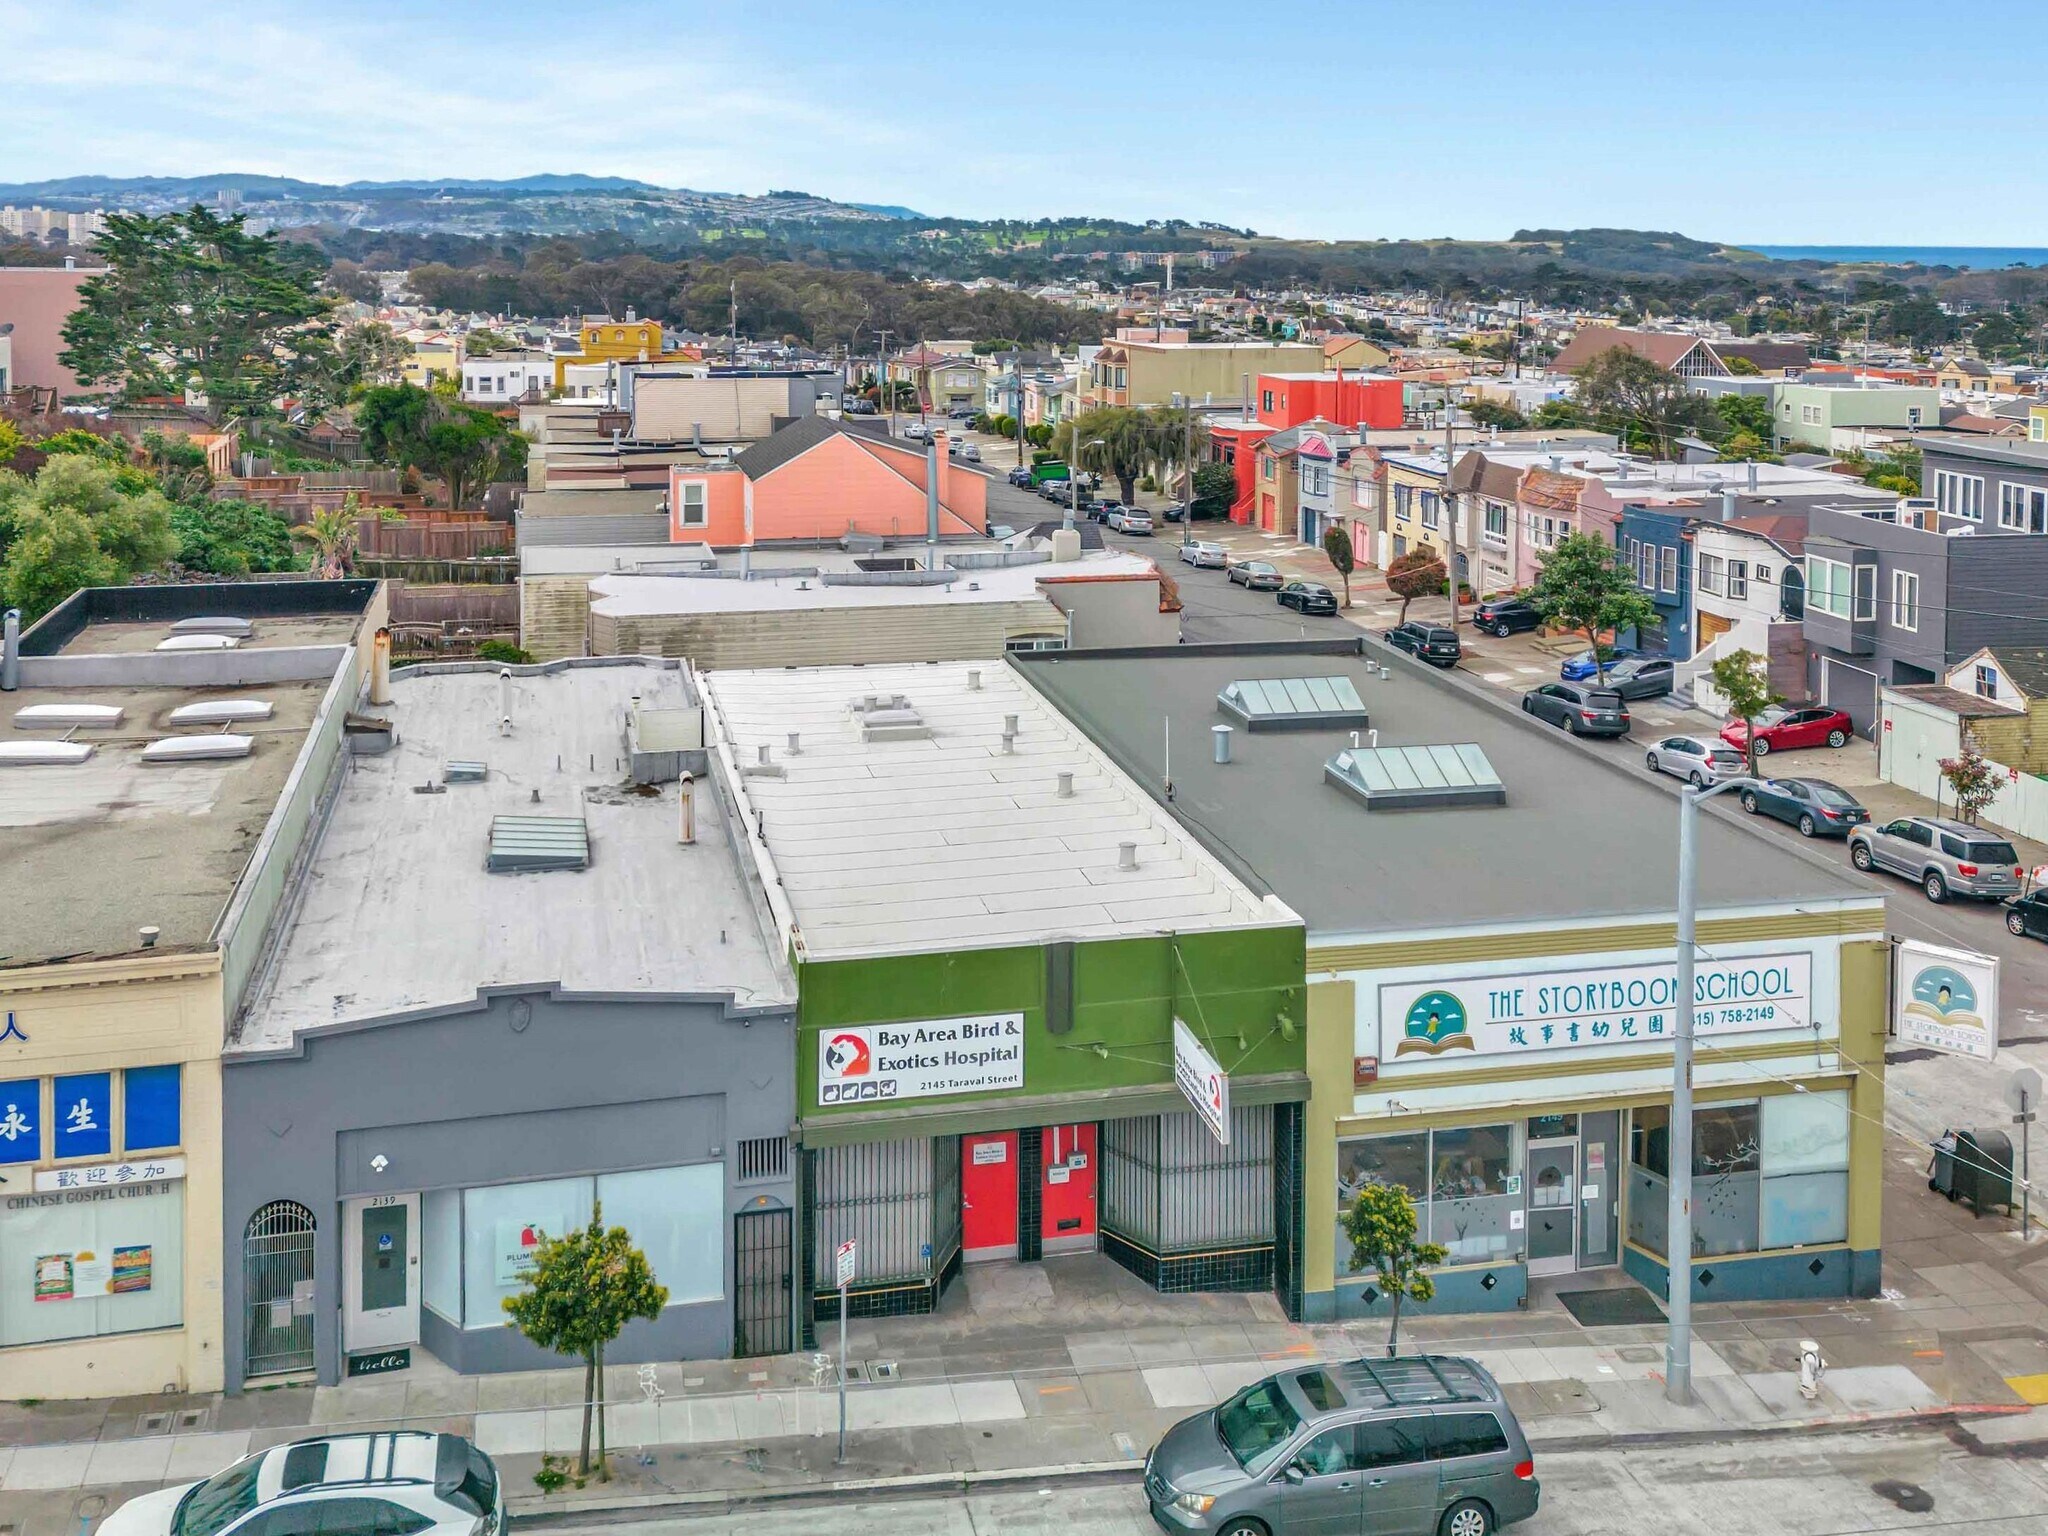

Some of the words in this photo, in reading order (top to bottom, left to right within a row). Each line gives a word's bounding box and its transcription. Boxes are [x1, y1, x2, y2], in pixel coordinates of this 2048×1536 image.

[1489, 989, 1524, 1019] THE
[1694, 967, 1794, 1002] SCHOOL
[1509, 1014, 1664, 1046] 故事書幼兒園
[1693, 1010, 1714, 1027] 15)
[1720, 1006, 1774, 1024] 758-2149
[878, 1031, 911, 1048] Bay
[914, 1028, 958, 1044] Area
[962, 1022, 1000, 1039] Bird
[1004, 1020, 1020, 1035] &
[878, 1054, 940, 1072] Exotics
[944, 1045, 1018, 1067] Hospital
[920, 1081, 945, 1090] 2145
[948, 1076, 985, 1088] Taraval
[988, 1074, 1018, 1085] Street
[57, 1164, 165, 1188] 歡迎參加
[7, 1194, 63, 1210] CHINESE
[66, 1188, 116, 1203] GOSPEL
[119, 1182, 171, 1198] CHURH
[372, 1196, 396, 1206] 2139
